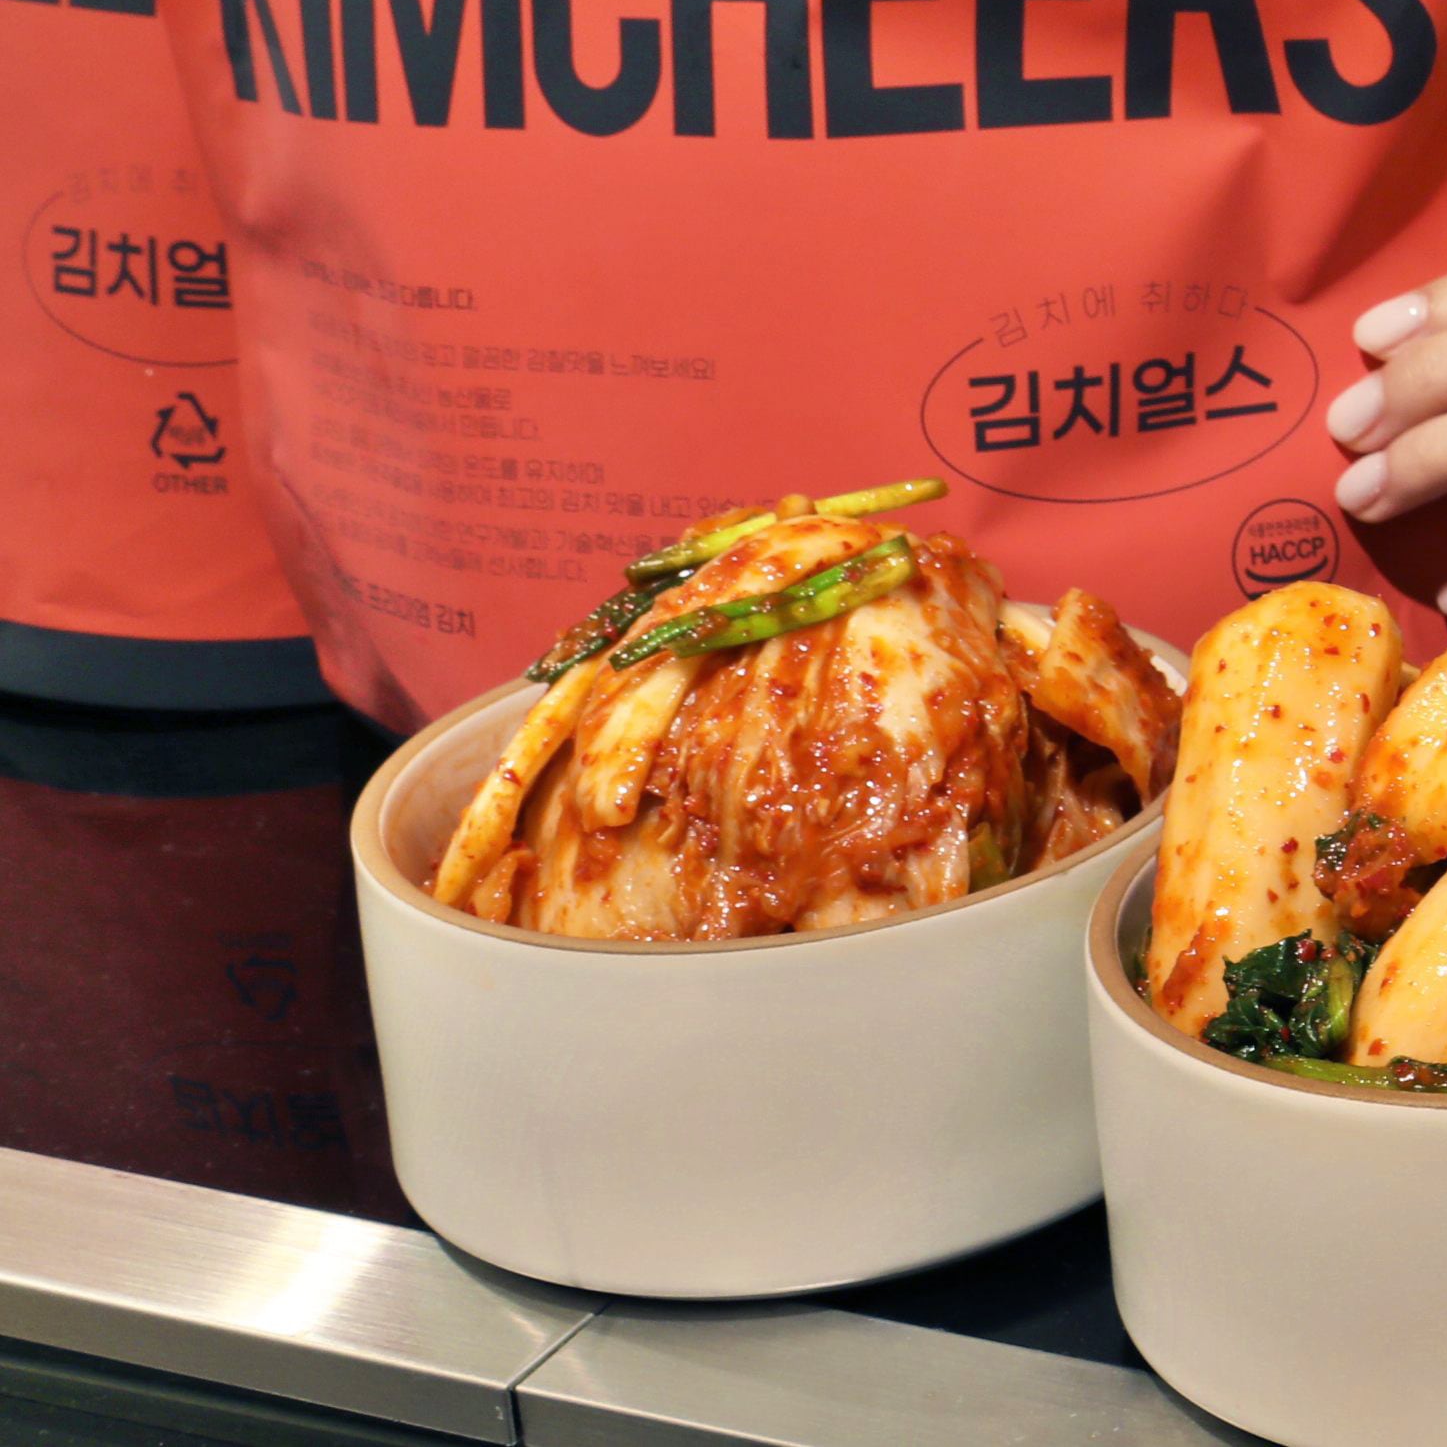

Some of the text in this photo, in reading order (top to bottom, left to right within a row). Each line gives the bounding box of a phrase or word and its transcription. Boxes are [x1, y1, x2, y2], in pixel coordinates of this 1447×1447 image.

[988, 284, 1117, 349] 김치에
[968, 344, 1278, 452] 김치얼스
[153, 473, 228, 495] OTHER
[1249, 536, 1325, 565] HACCP
